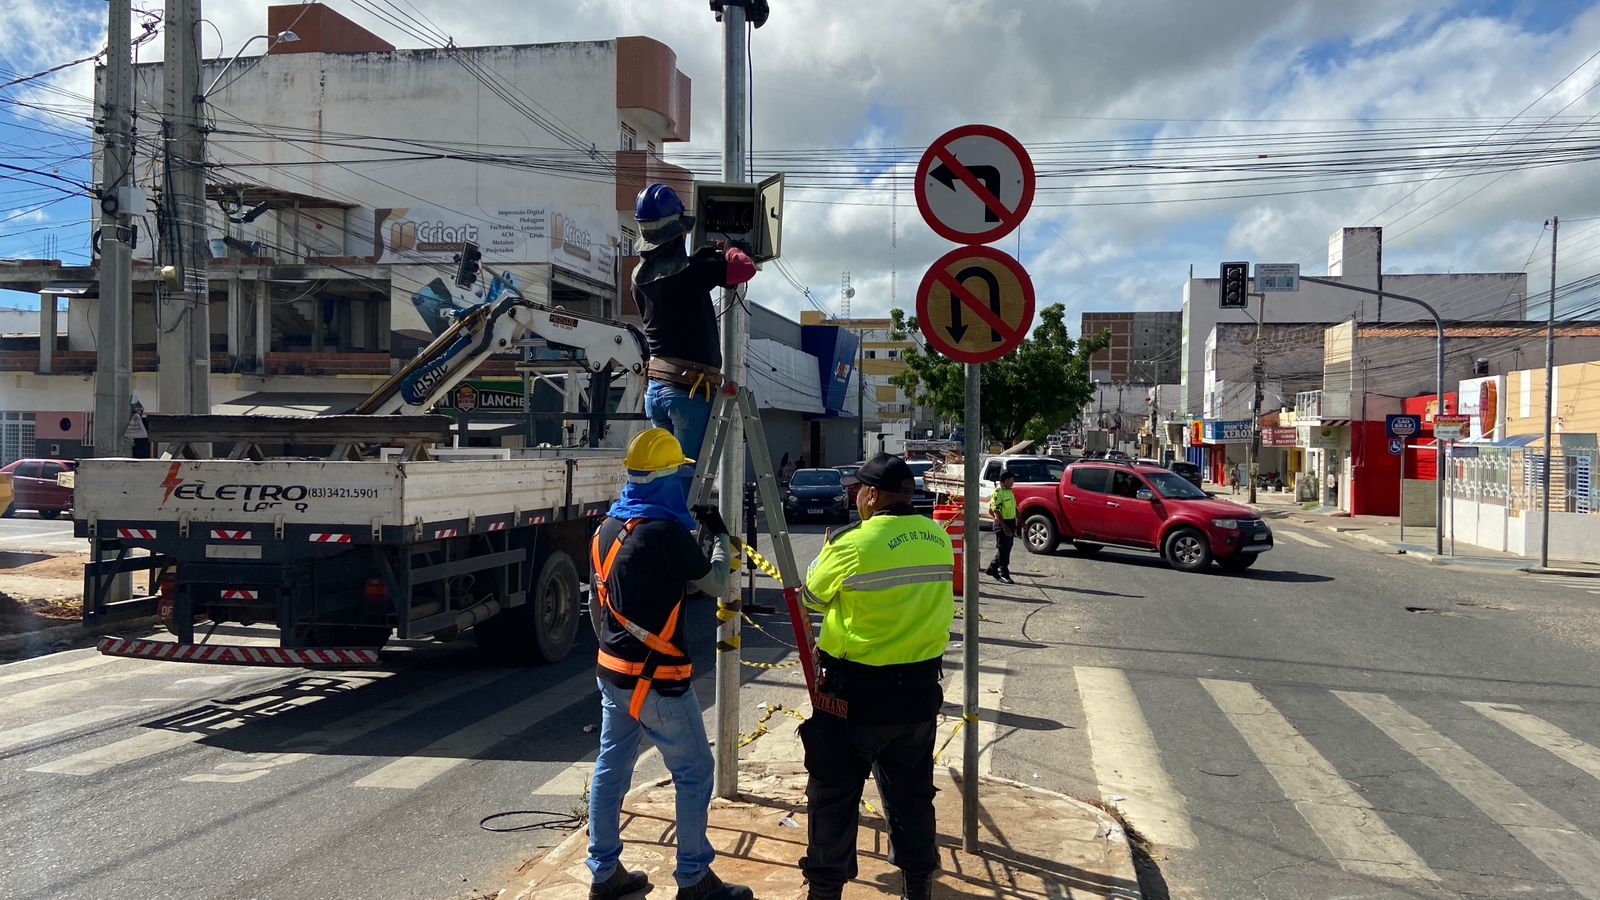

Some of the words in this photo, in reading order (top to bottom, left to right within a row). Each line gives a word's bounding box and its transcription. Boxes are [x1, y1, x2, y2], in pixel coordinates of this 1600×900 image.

[416, 221, 478, 244] Criart
[482, 394, 530, 407] LANCHE
[888, 533, 909, 550] AGENTE
[909, 531, 918, 540] DE
[919, 530, 945, 548] TRÂNSITO
